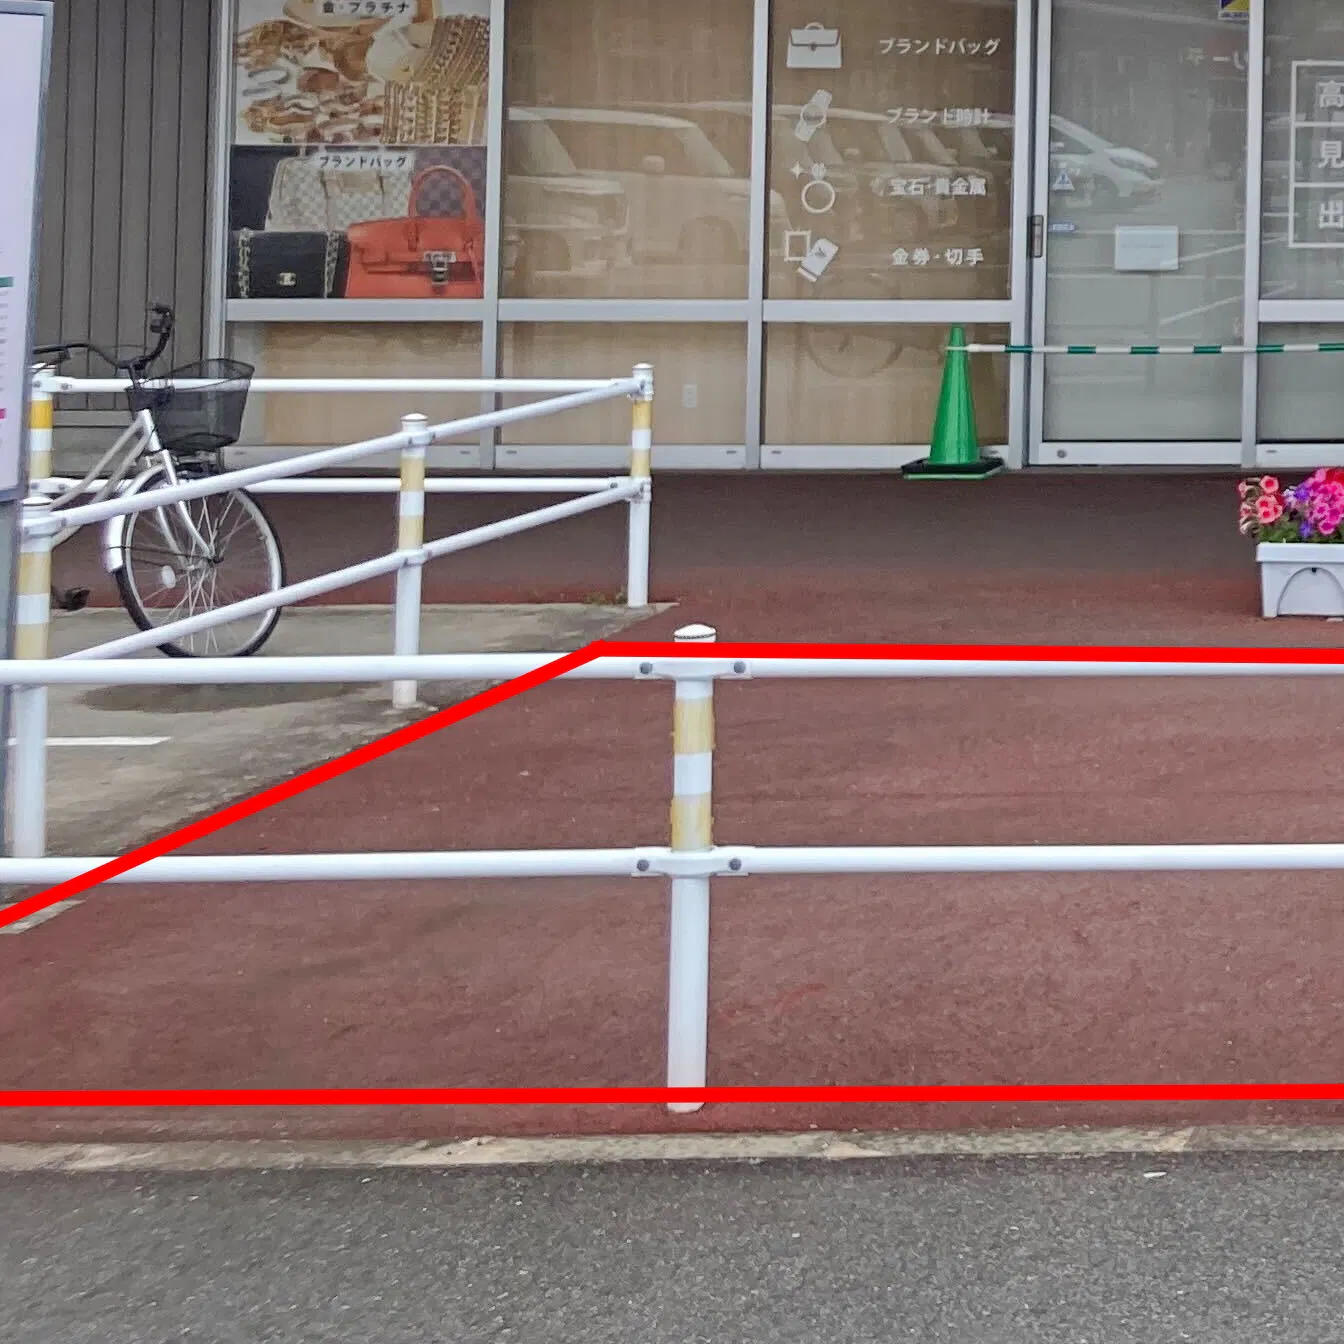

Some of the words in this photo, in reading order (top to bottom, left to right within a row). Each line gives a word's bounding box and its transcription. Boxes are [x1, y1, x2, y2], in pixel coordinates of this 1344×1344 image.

[879, 38, 1001, 56] ブランドバッグ
[319, 154, 408, 169] ブランドバッグ
